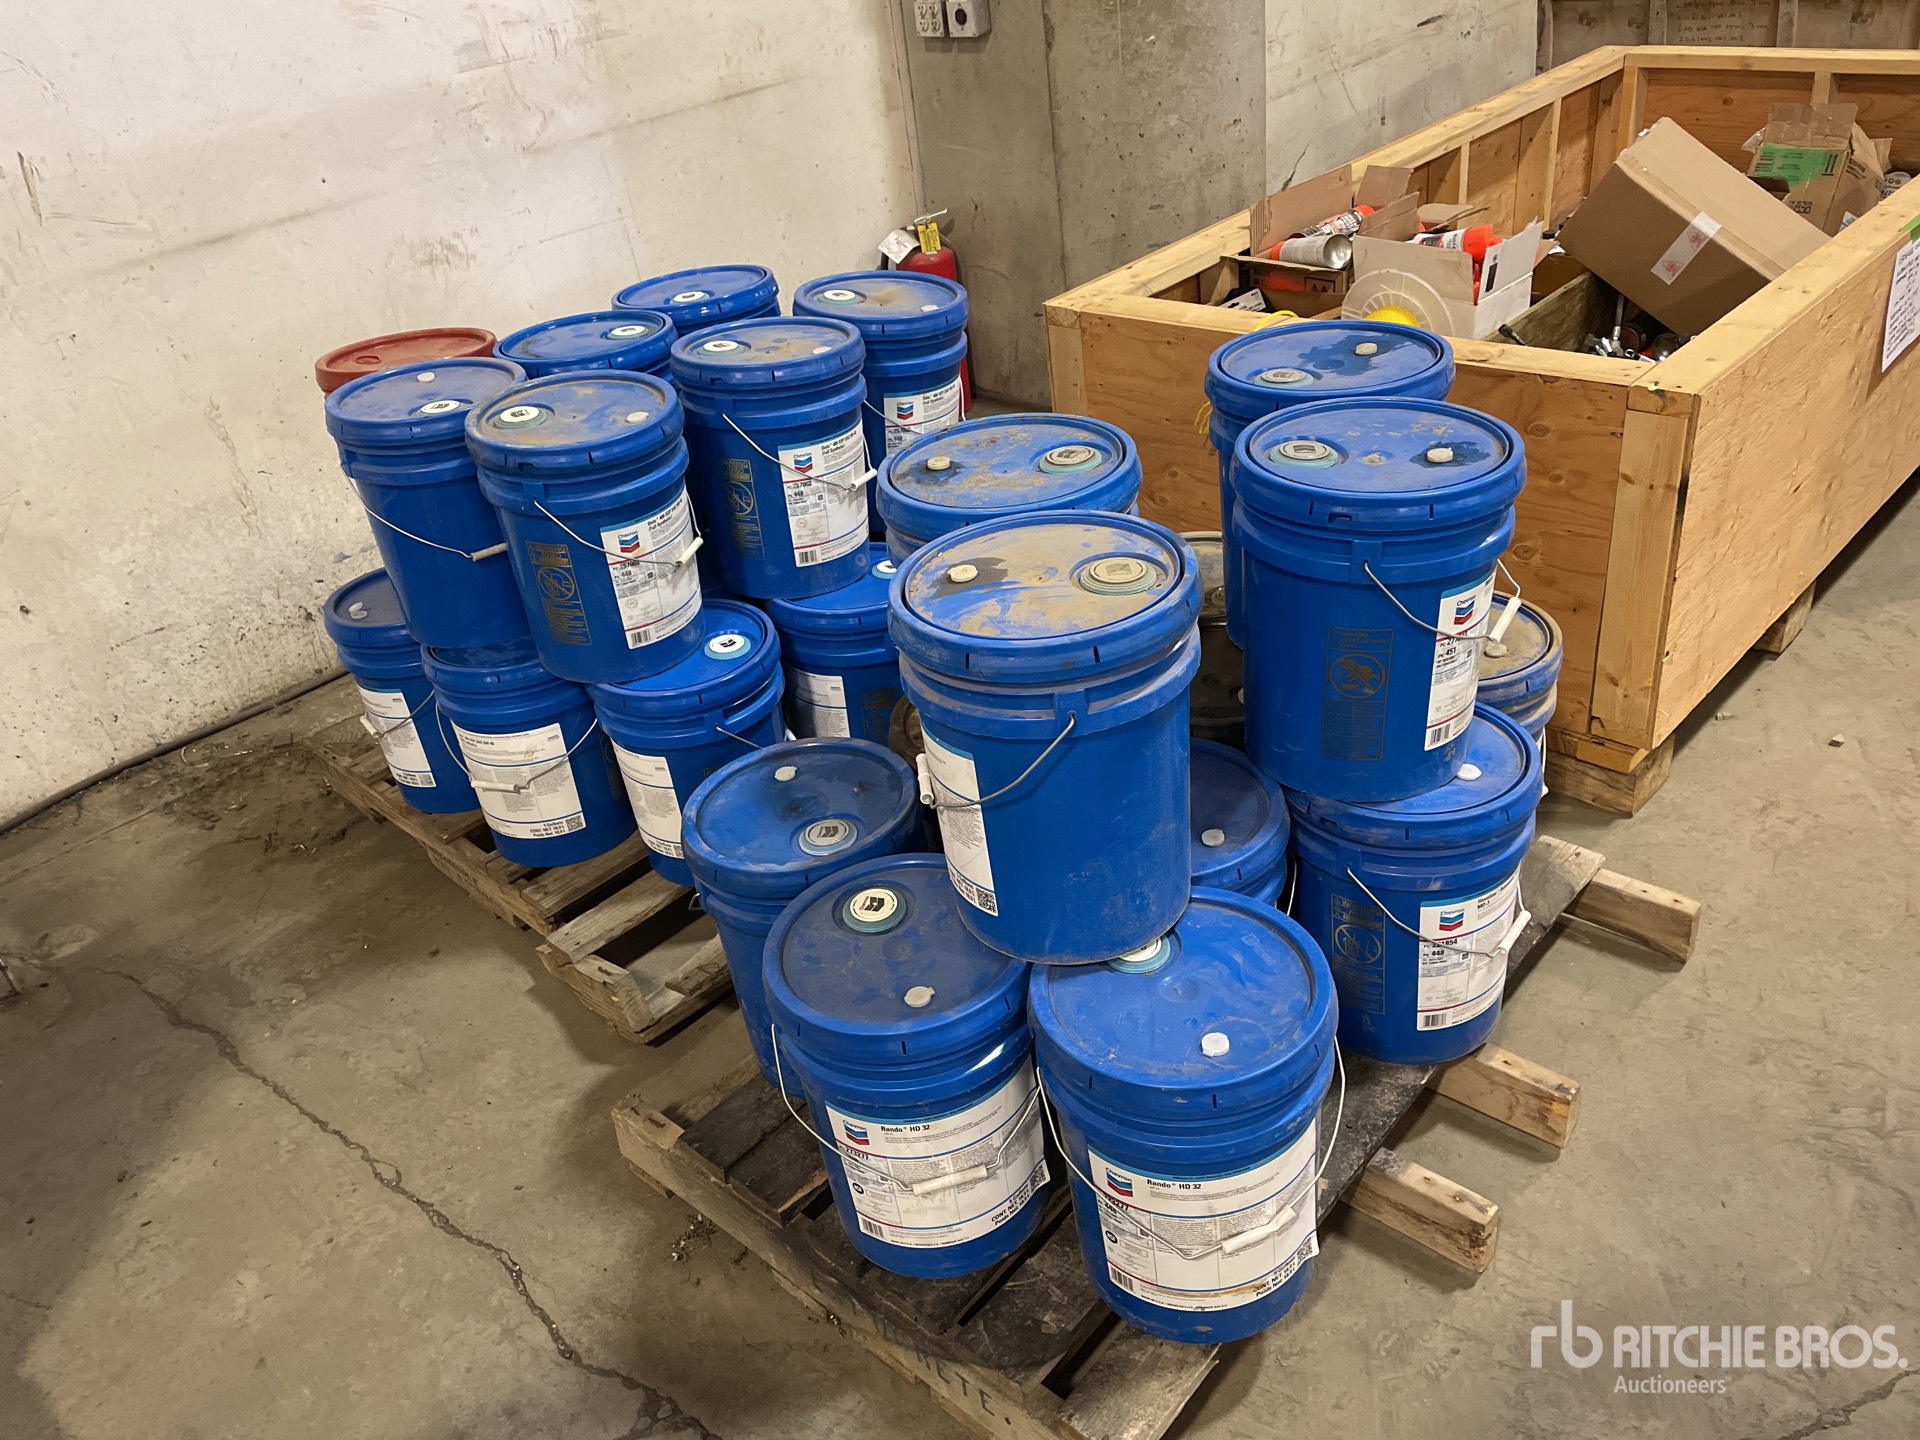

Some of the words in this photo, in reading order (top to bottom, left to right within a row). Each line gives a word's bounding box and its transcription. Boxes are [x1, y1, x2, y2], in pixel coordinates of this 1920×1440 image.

[617, 530, 639, 539] Chevron
[1440, 908, 1465, 916] Chevron
[1431, 949, 1445, 957] 448
[842, 1119, 867, 1131] Chevron
[880, 1125, 903, 1133] Rando
[1105, 1167, 1133, 1183] Chevron
[1146, 1179, 1171, 1189] Rando
